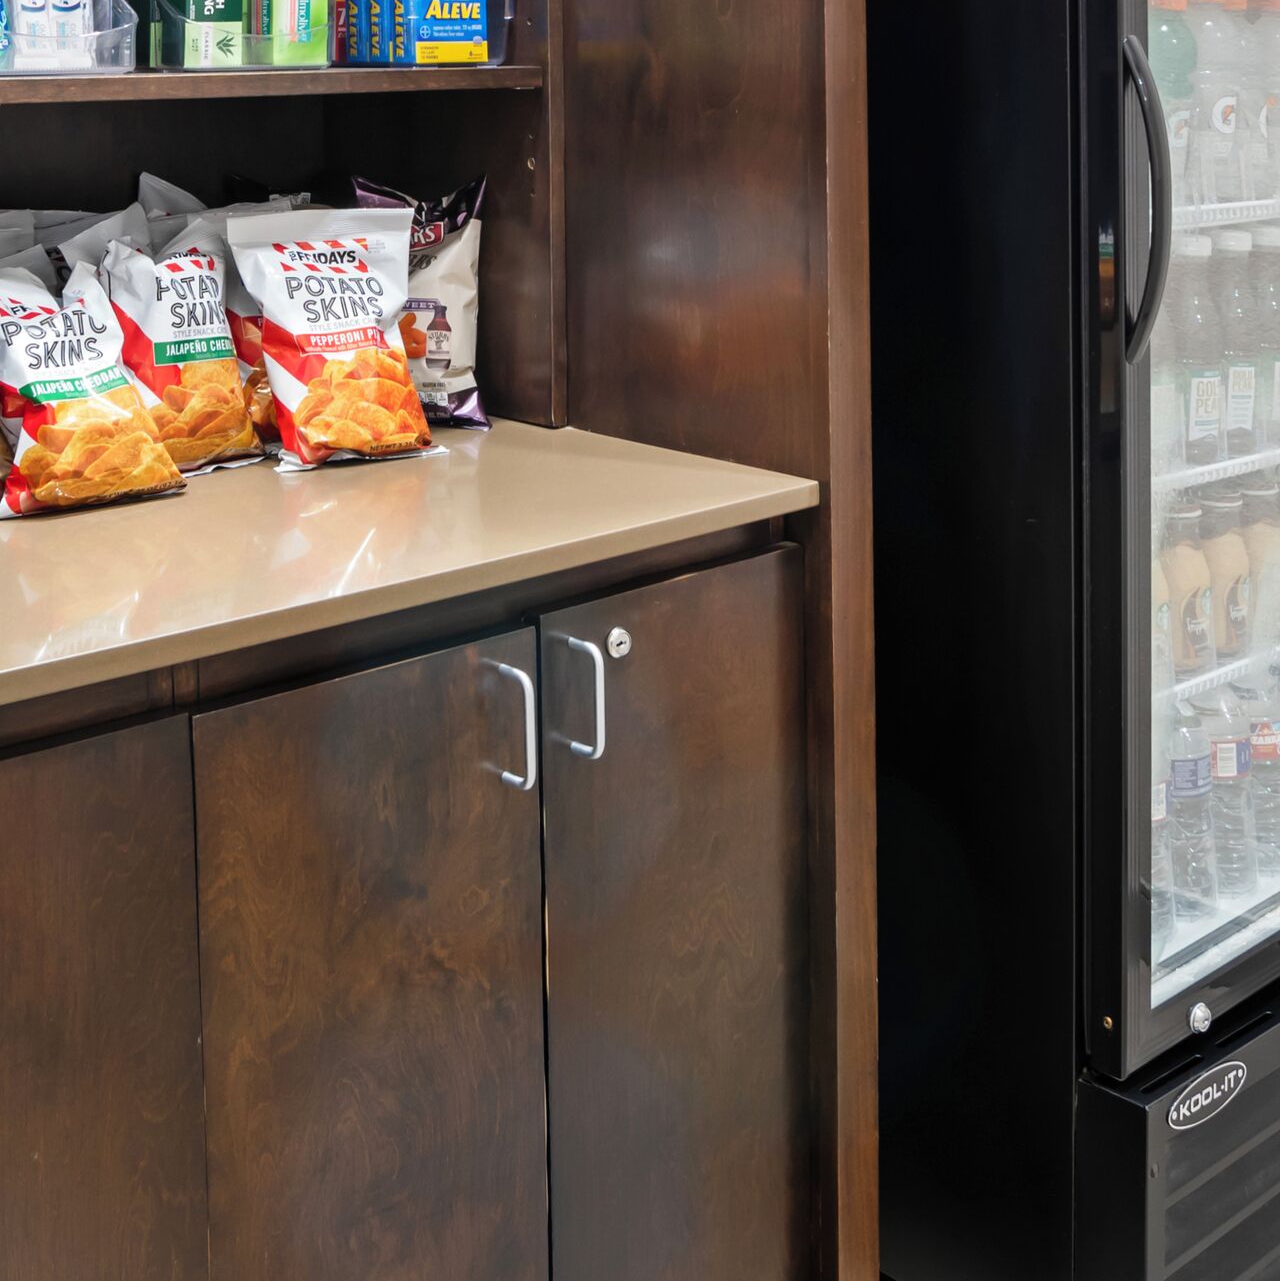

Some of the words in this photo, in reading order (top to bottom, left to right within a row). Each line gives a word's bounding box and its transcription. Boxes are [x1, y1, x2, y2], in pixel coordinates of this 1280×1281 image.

[348, 0, 359, 57] ALEVE
[370, 0, 380, 57] ALEVE
[285, 276, 383, 299] POTATO
[303, 296, 383, 323] SKINS
[174, 329, 192, 338] STYLE
[193, 328, 214, 337] SNACK
[309, 322, 332, 332] STYLE
[334, 320, 360, 330] SNACK
[310, 331, 364, 346] PEPPERONI
[25, 338, 104, 369] SKINS
[166, 340, 207, 356] JALAPEÑO
[30, 380, 73, 397] JALAPEÑO
[1196, 398, 1216, 415] PEA
[371, 444, 382, 452] NET
